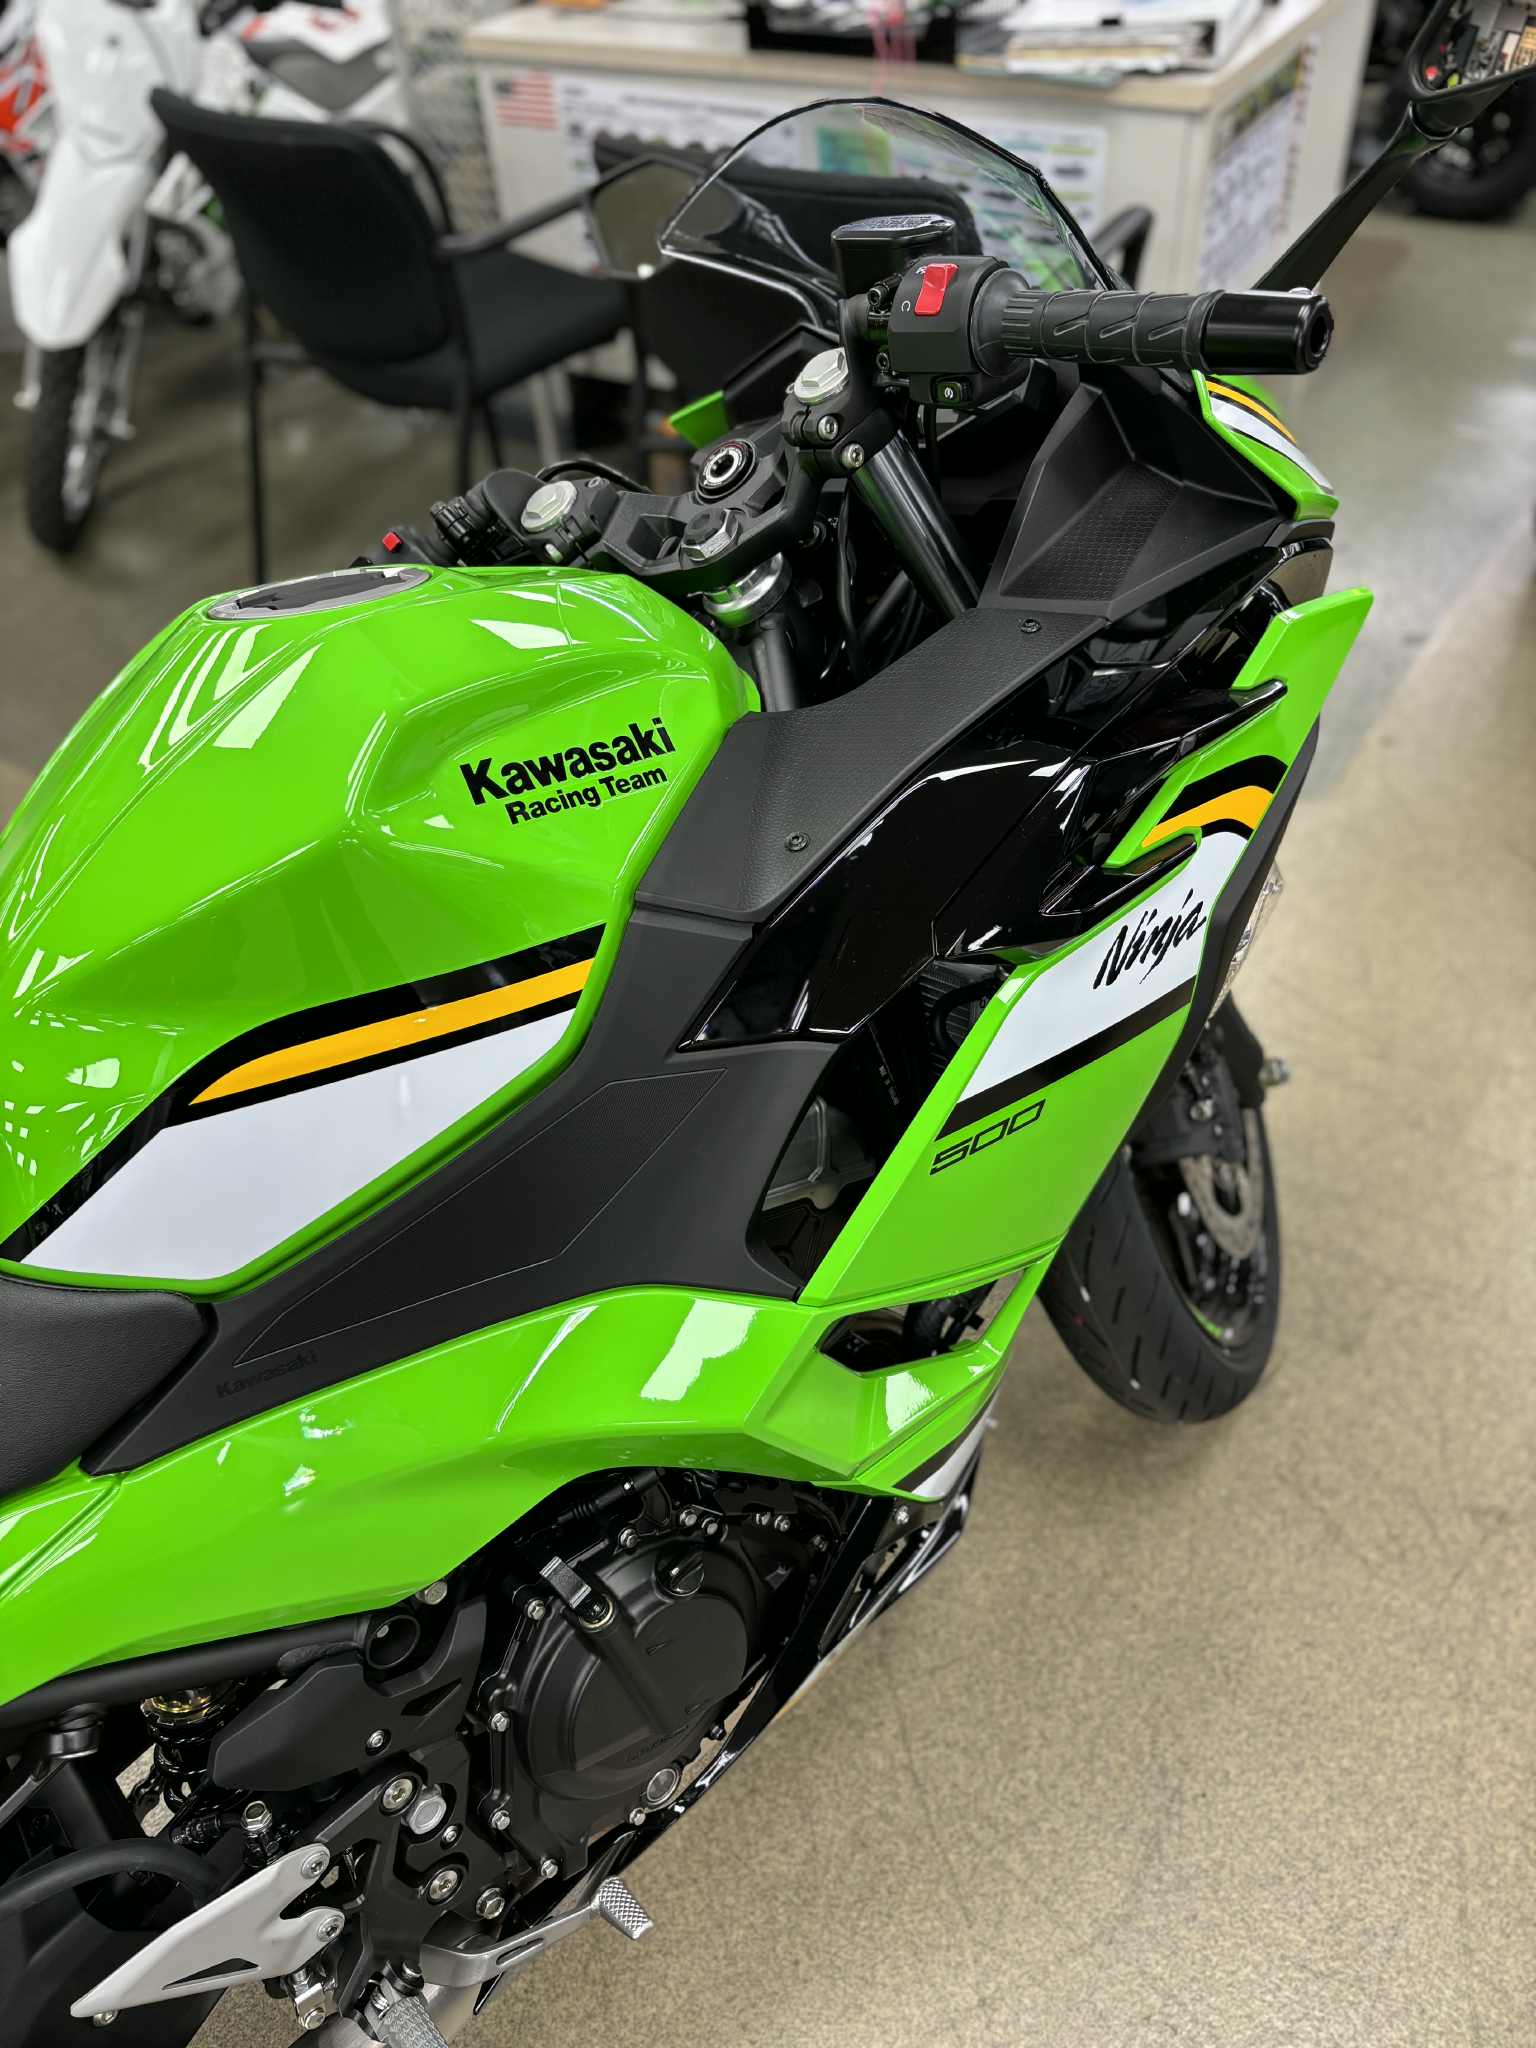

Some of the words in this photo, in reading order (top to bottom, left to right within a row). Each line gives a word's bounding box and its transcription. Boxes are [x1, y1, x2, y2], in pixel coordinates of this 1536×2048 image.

[459, 717, 676, 806] Kawasaki
[504, 785, 601, 825] Racing
[600, 767, 668, 798] Team
[1092, 888, 1207, 990] Ninja
[929, 1098, 1046, 1176] 500
